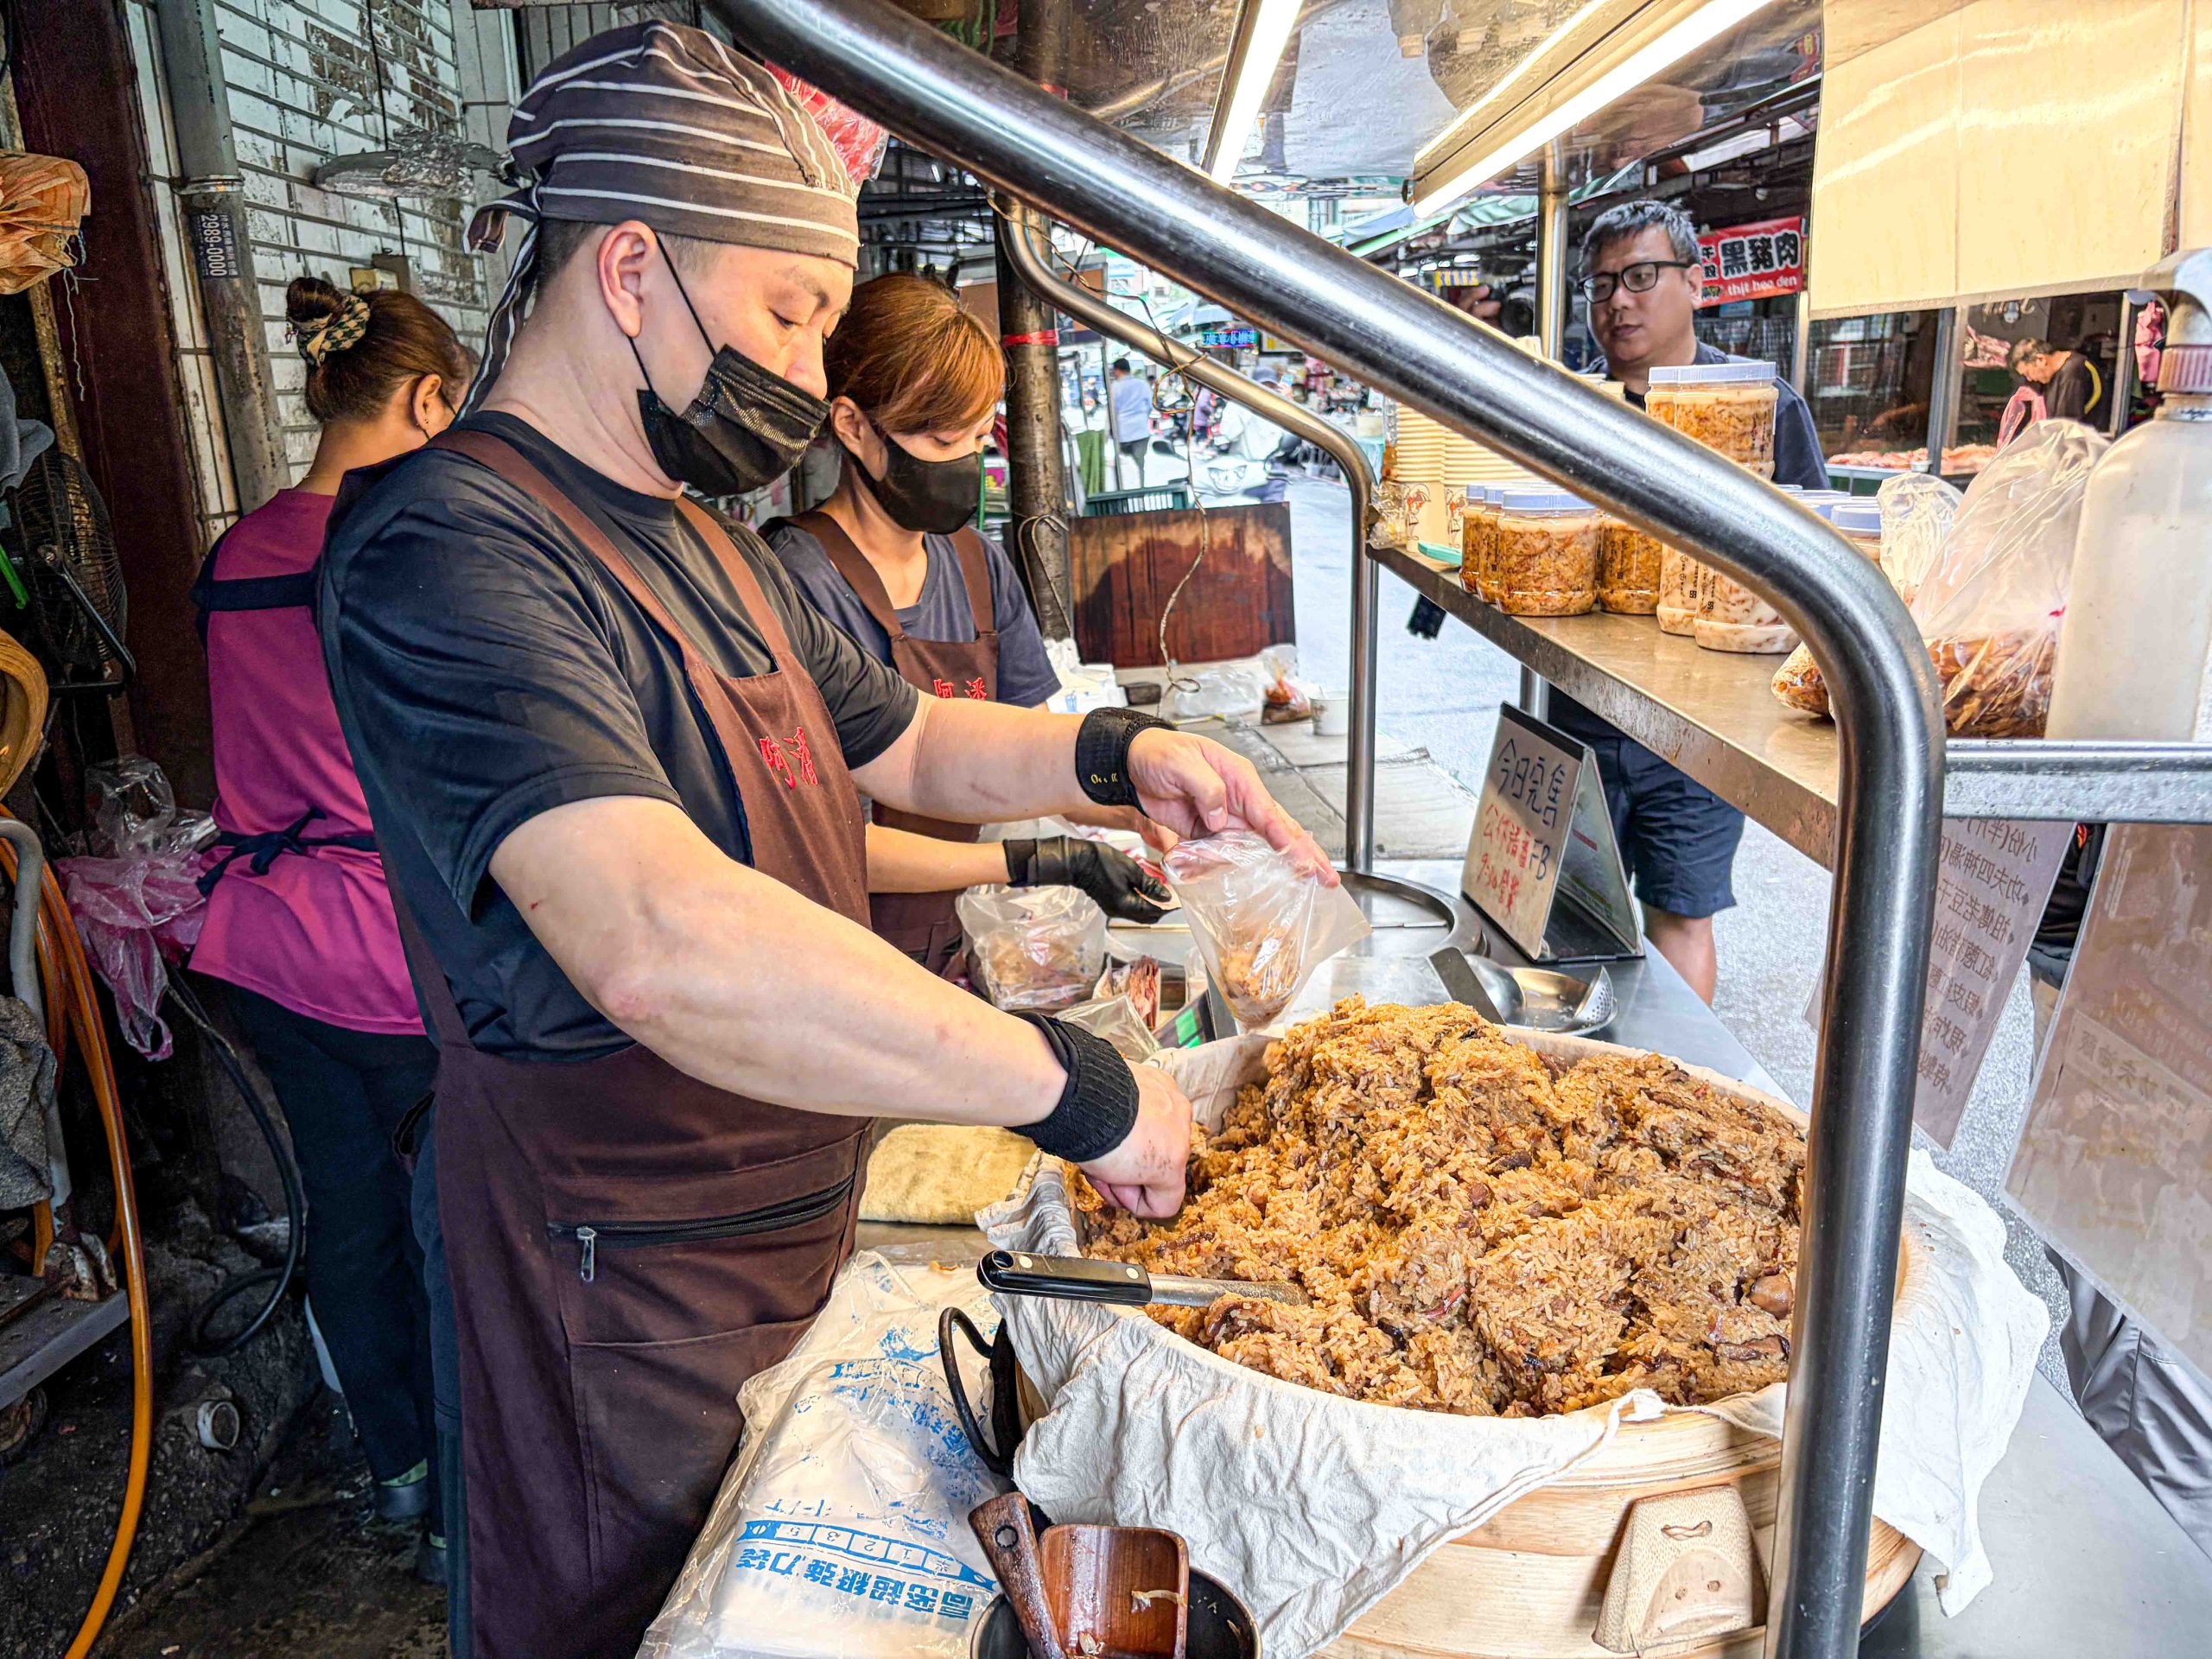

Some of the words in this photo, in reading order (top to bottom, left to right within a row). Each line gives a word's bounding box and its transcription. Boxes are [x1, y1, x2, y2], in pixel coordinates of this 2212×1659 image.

[200, 214, 227, 276] 2989-0000
[1720, 232, 1800, 277] 黑豬肉
[1497, 738, 1566, 830] 今日完售
[826, 1531, 842, 1542] 3
[864, 1541, 879, 1552] 2
[735, 1548, 975, 1620] 高密超級強力袋
